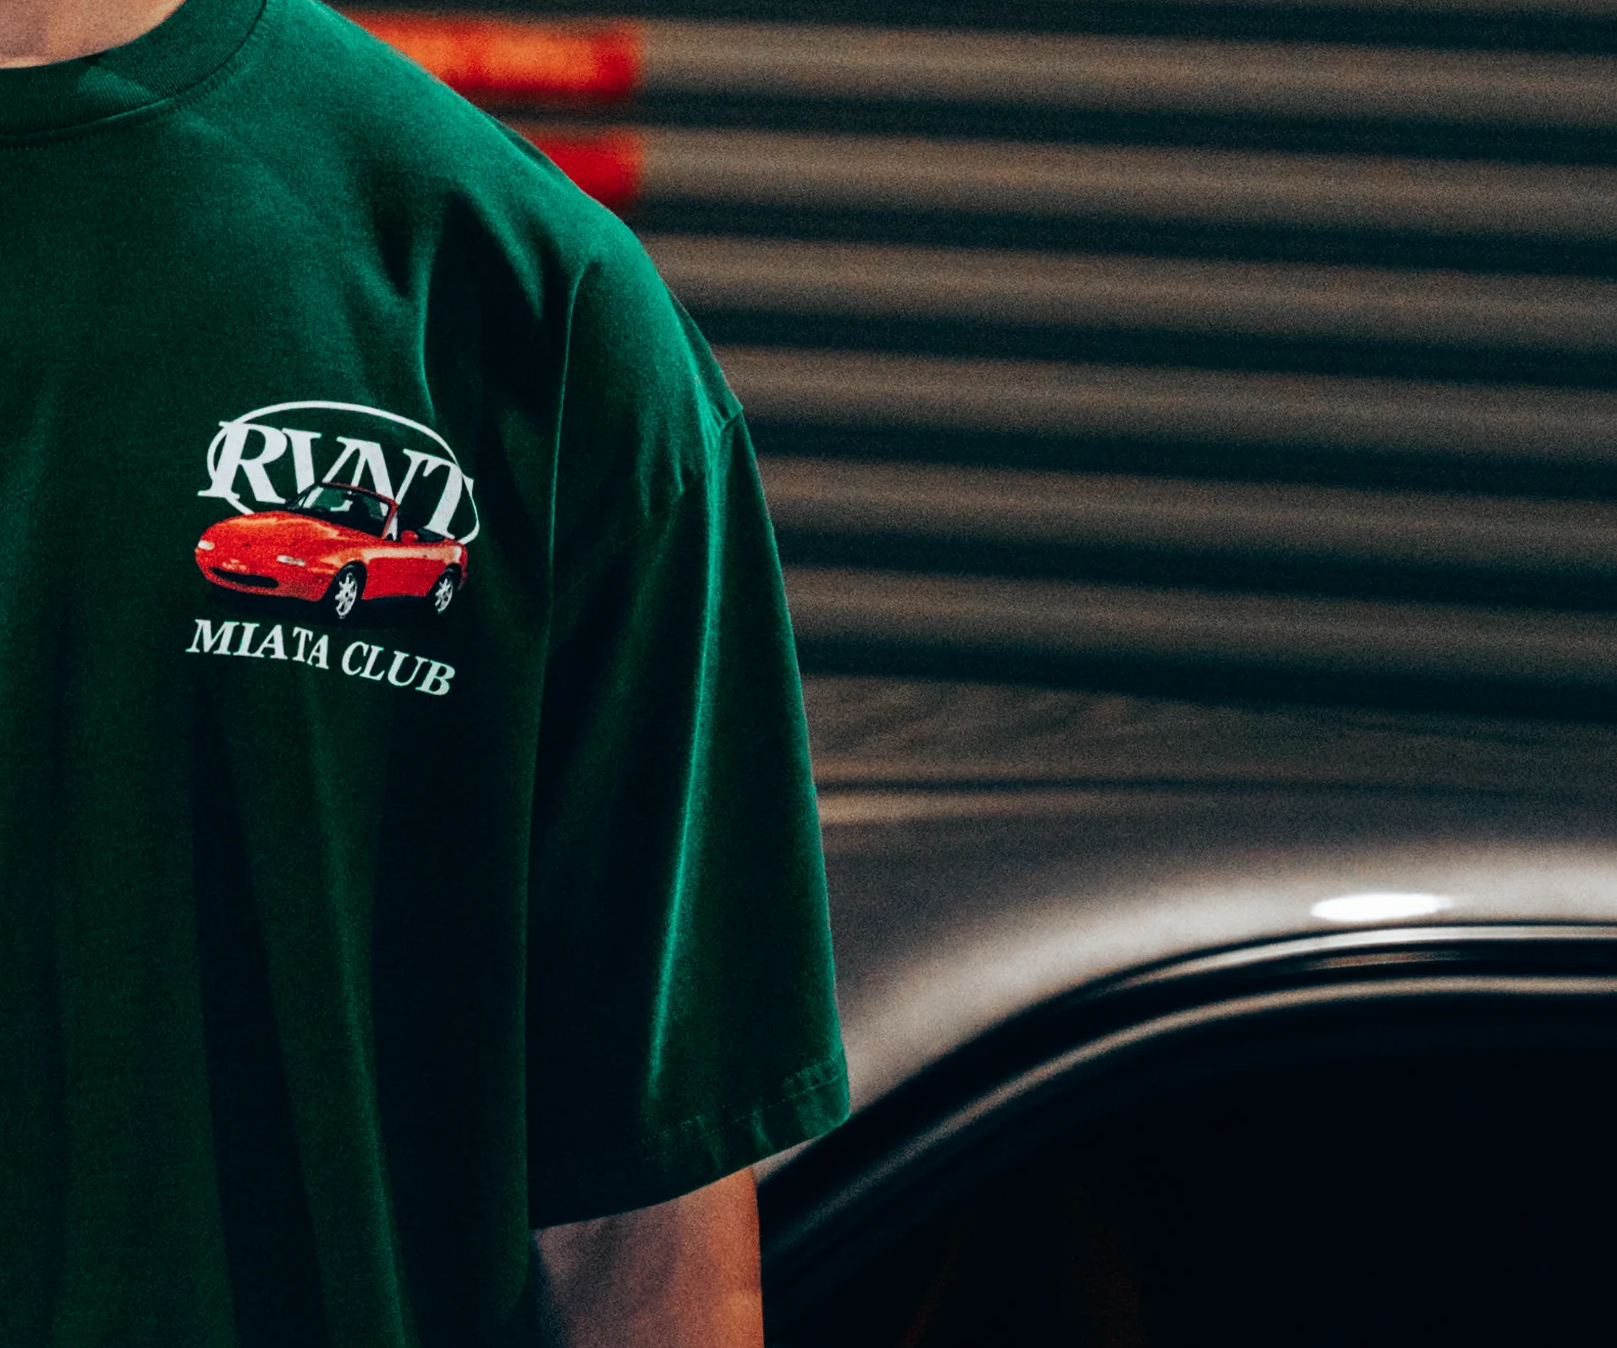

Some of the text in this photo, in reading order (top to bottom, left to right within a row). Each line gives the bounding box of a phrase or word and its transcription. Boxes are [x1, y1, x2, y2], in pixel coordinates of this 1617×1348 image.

[198, 421, 474, 540] RVNT
[186, 618, 456, 696] MIATA CLUB
